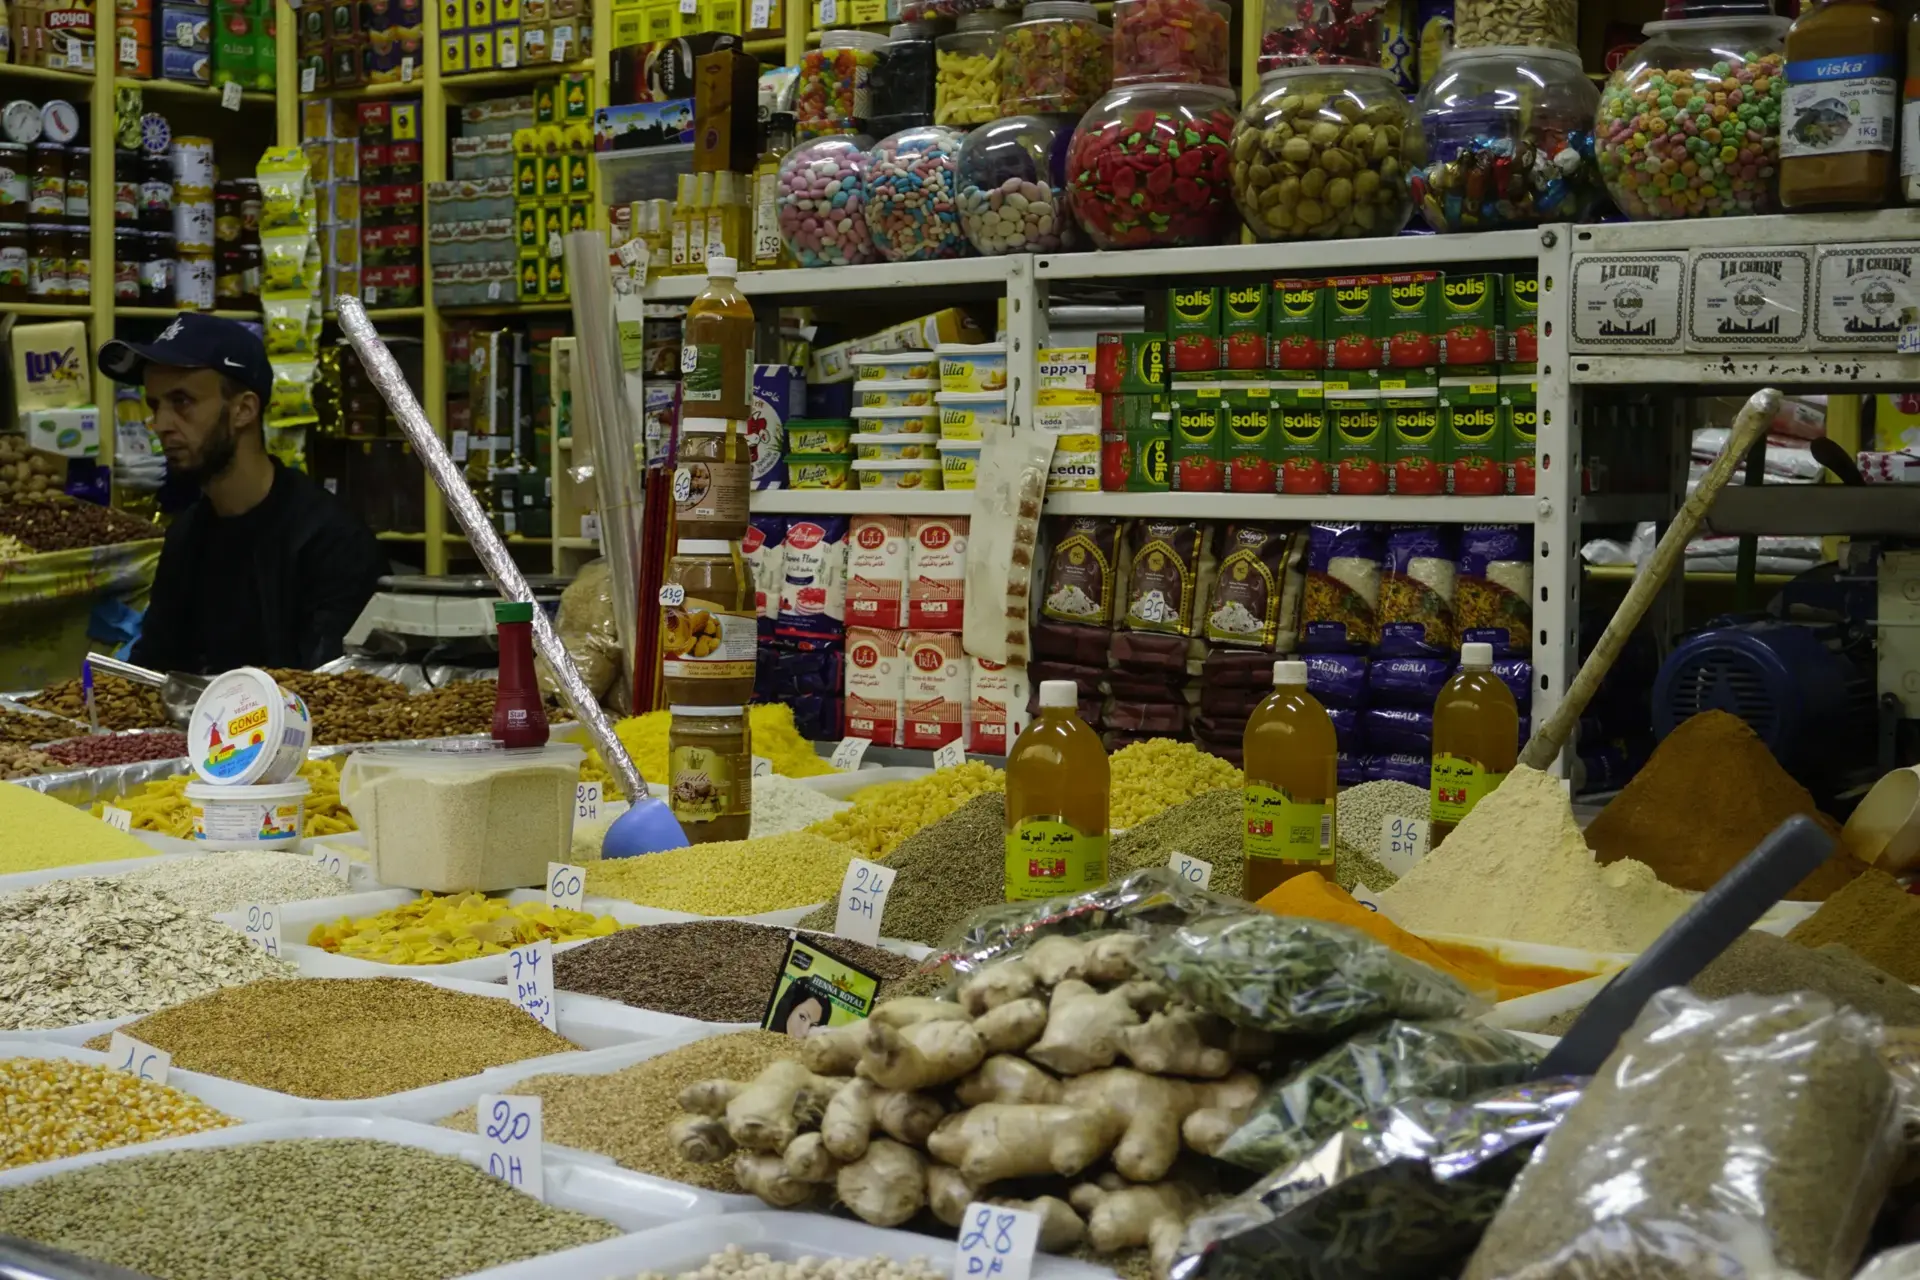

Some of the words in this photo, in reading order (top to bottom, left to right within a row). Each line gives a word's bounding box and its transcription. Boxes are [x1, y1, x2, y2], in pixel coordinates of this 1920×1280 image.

[50, 12, 90, 26] Royal
[1817, 61, 1864, 76] viska
[760, 236, 779, 250] 150
[1601, 265, 1616, 283] LA
[1618, 265, 1659, 284] CHAINE
[1720, 261, 1736, 280] LA
[1739, 261, 1782, 281] CHAINE
[1846, 258, 1864, 278] LA
[1867, 258, 1911, 278] CHAINE
[1337, 286, 1369, 301] solis
[1392, 282, 1425, 299] solis
[1445, 279, 1485, 296] solis
[1175, 291, 1212, 307] solis
[1229, 288, 1261, 304] solis
[1284, 290, 1315, 304] solis
[943, 362, 964, 376] lilia
[1040, 364, 1087, 375] Ledda
[1151, 342, 1163, 383] solis
[944, 411, 966, 424] lilia
[1180, 412, 1216, 427] solis
[1232, 412, 1268, 427] solis
[1284, 412, 1322, 428] solis
[1340, 411, 1378, 427] solis
[1396, 411, 1436, 427] solis
[1454, 409, 1495, 426] solis
[945, 457, 967, 471] lilia
[1155, 440, 1167, 482] solis
[660, 588, 682, 599] 130
[1144, 599, 1164, 621] 35
[1311, 662, 1346, 673] CIGALA
[1391, 663, 1427, 673] CIGALA
[1491, 666, 1509, 675] ALA
[234, 701, 258, 714] VEGETAL
[229, 709, 267, 735] GONGA
[938, 746, 956, 765] 13
[1390, 753, 1425, 764] CIGALA
[576, 785, 597, 803] 20
[579, 805, 596, 819] DH
[1391, 820, 1417, 841] 96
[1391, 841, 1413, 856] DH
[552, 867, 580, 898] 60
[852, 868, 884, 899] 24
[849, 897, 873, 919] DH
[246, 906, 273, 932] 20
[510, 949, 541, 979] 74
[518, 981, 537, 1000] DH
[811, 976, 838, 995] HENNA
[838, 989, 866, 1010] ROYAL
[486, 1100, 530, 1144] 20
[489, 1152, 523, 1186] DH
[961, 1209, 1016, 1254] 28
[967, 1256, 1003, 1278] DH
